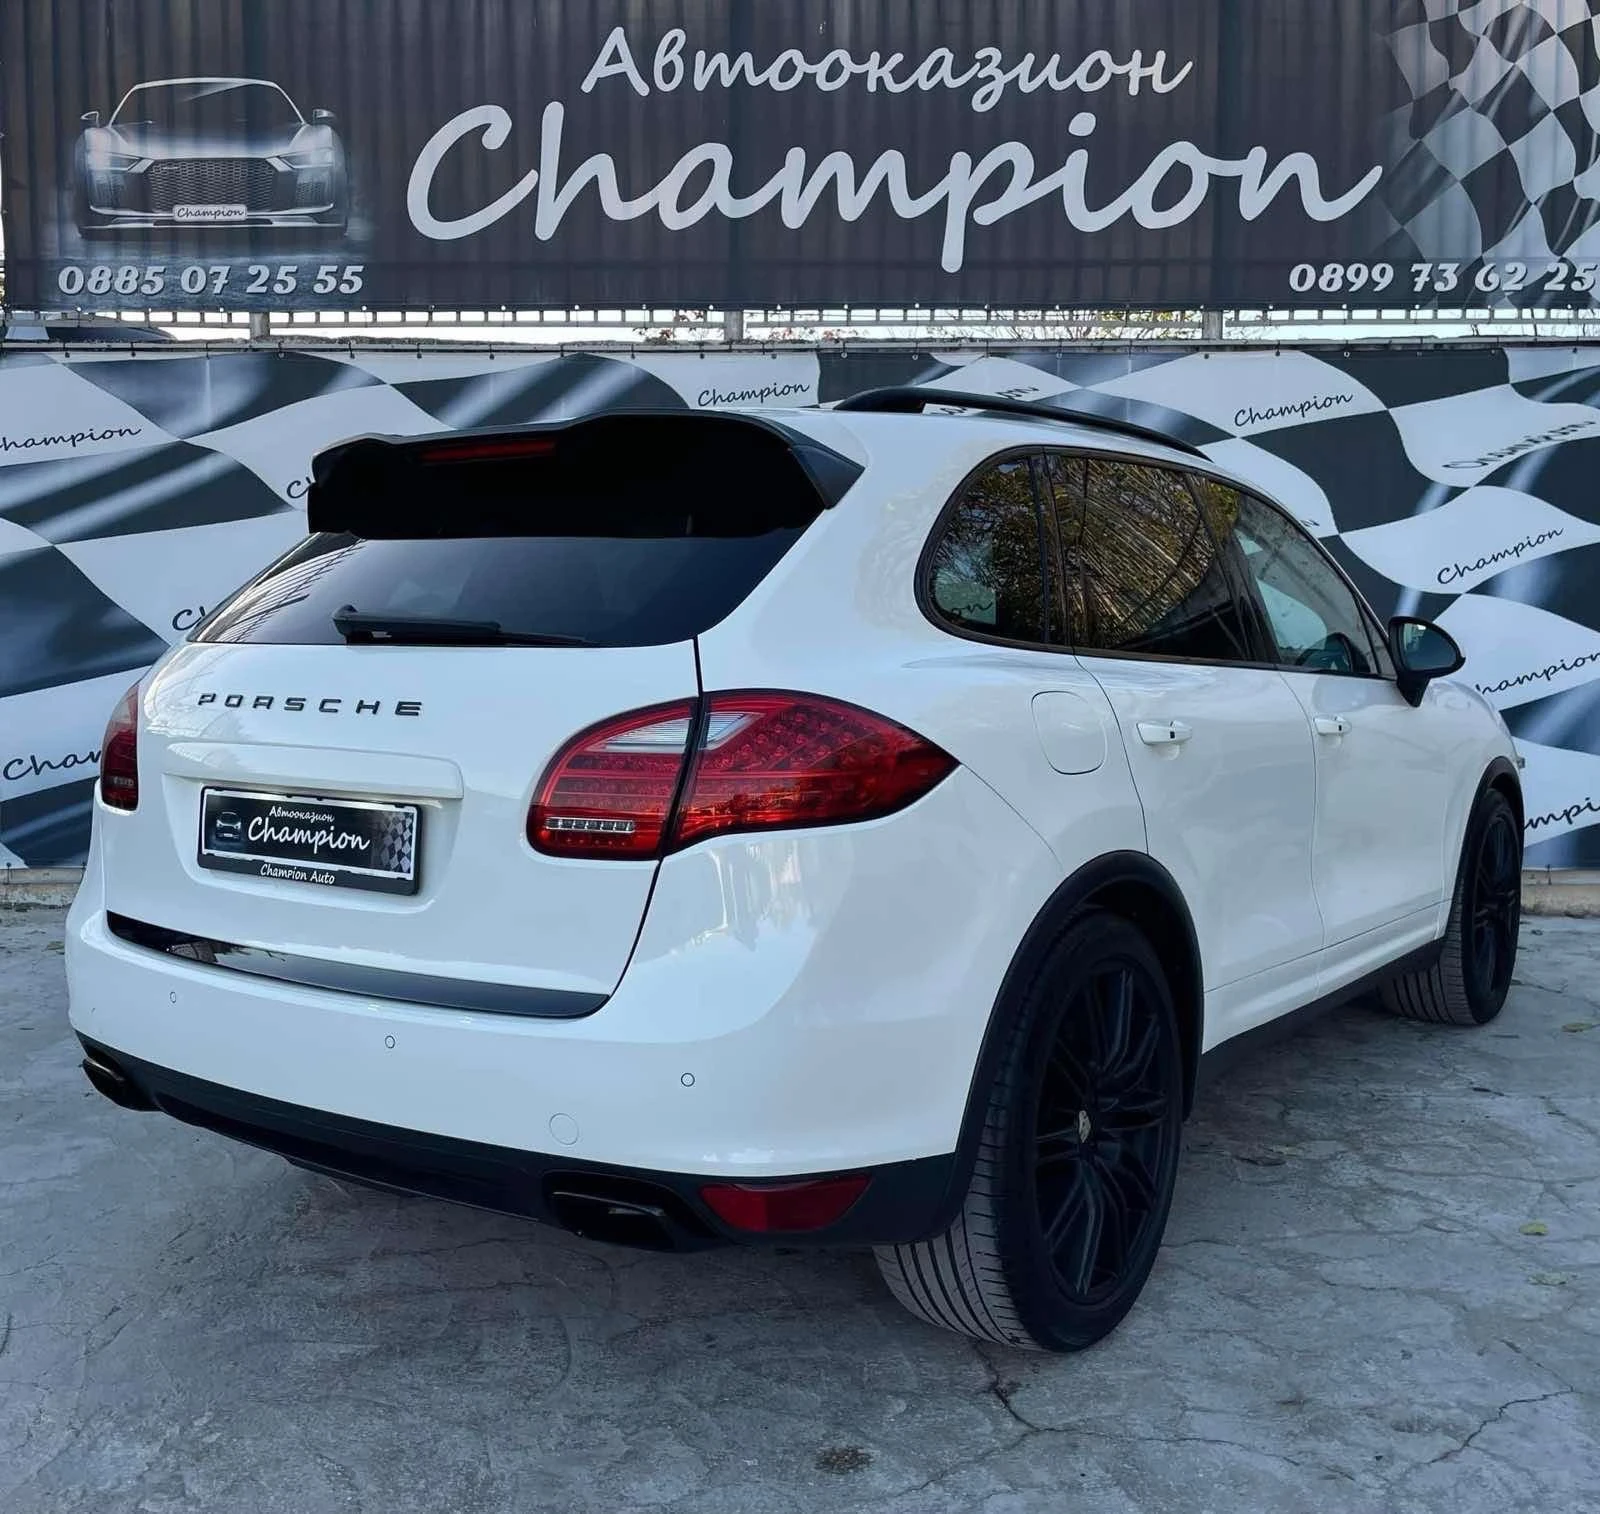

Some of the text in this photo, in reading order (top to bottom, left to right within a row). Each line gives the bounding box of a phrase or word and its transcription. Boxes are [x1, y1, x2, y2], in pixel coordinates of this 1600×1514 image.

[580, 26, 1193, 112] Автооказион
[406, 101, 1383, 274] Champion
[176, 206, 245, 219] Champion
[58, 265, 365, 295] 0885 07 25 55
[1289, 262, 1600, 293] 0899 73 62 25
[697, 382, 810, 407] Champion
[1234, 394, 1354, 427] Champion
[0, 428, 142, 452] hampion
[1437, 527, 1564, 585] Champion
[197, 692, 423, 717] PORSCHE
[248, 815, 371, 854] Champion
[260, 863, 335, 885] Champion Auto
